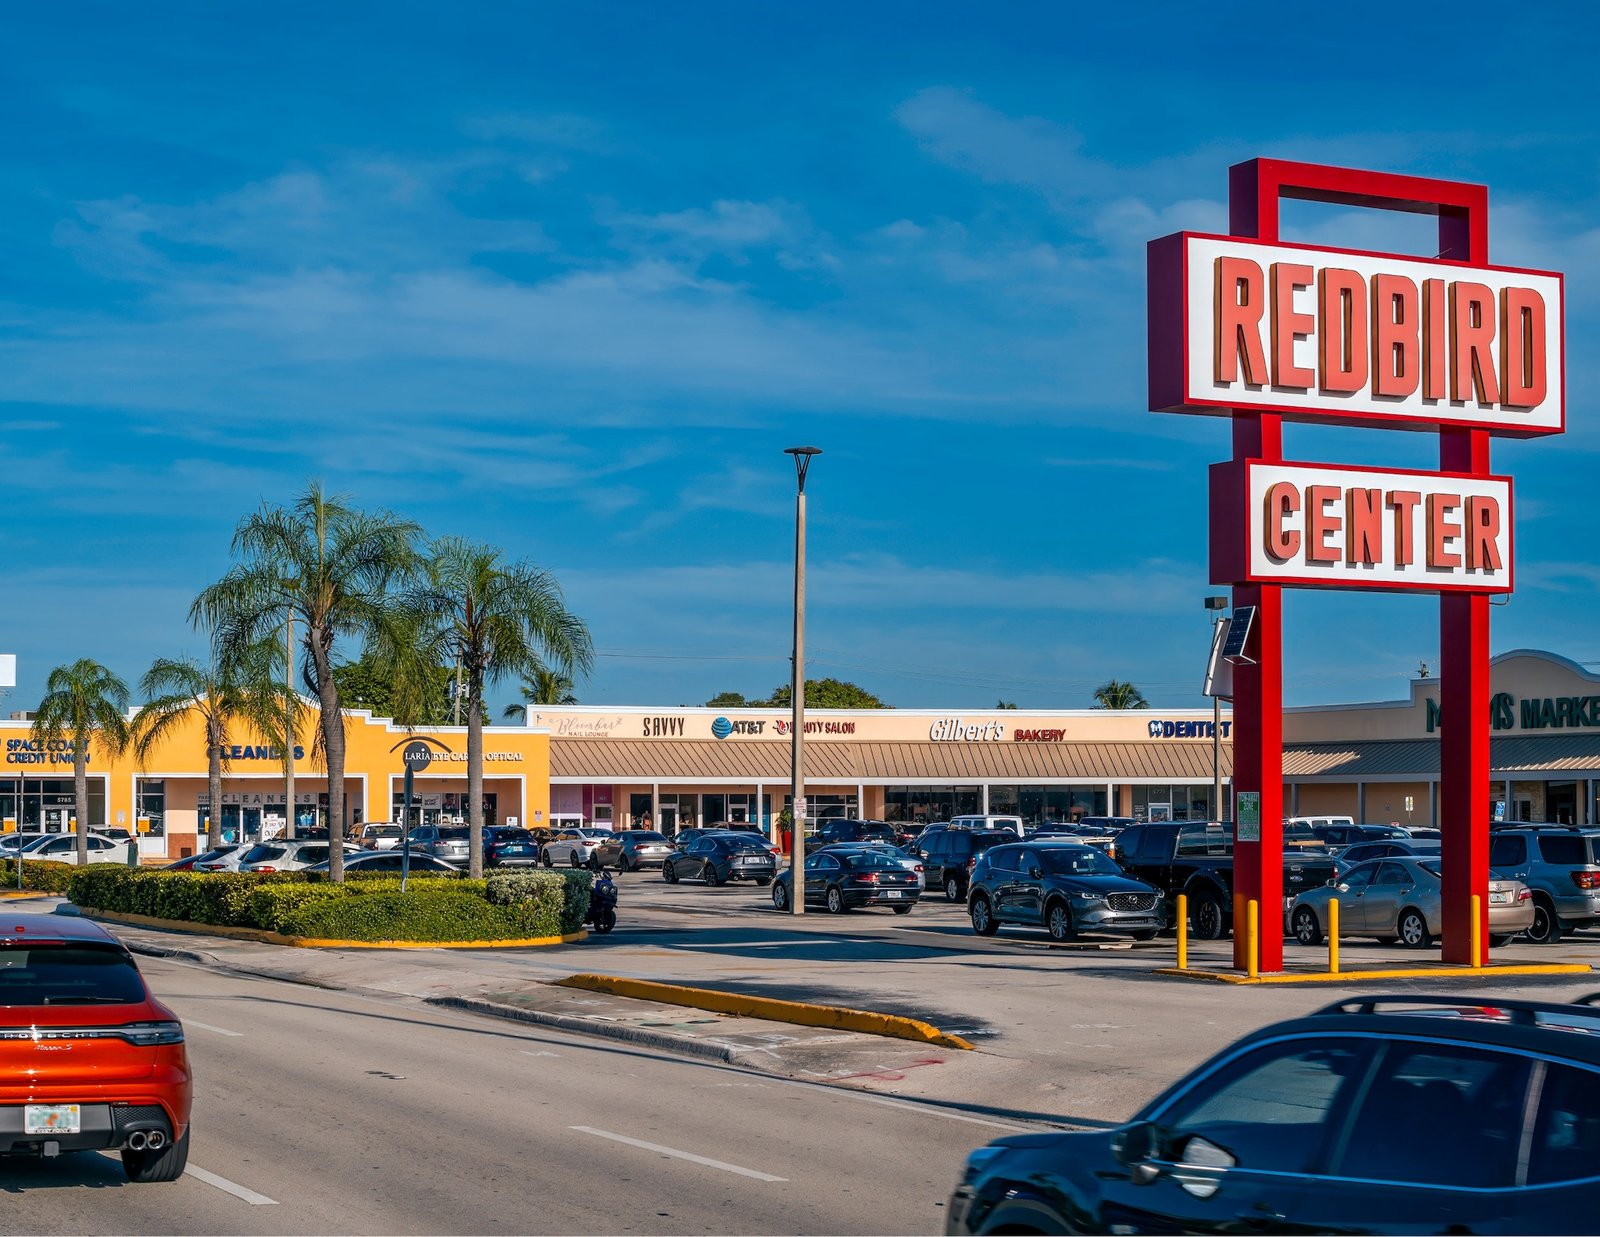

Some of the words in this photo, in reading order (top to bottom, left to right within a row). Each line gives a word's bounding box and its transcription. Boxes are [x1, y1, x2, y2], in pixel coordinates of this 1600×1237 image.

[1213, 256, 1546, 407] REDBIRD
[1264, 481, 1502, 570] CENTER
[643, 717, 685, 736] SAVVY
[731, 720, 766, 734] AT&T
[825, 722, 855, 734] SALON
[930, 718, 1005, 741] Gilbert's
[1014, 729, 1066, 742] BAKERY
[6, 739, 44, 752] SPACE
[47, 739, 89, 752] COAT
[206, 745, 305, 760] LEANES
[6, 753, 47, 763] CREDIT
[405, 752, 430, 760] LARIA
[432, 752, 449, 761] EYE
[450, 752, 469, 761] CAR
[486, 752, 523, 761] OPTICAL
